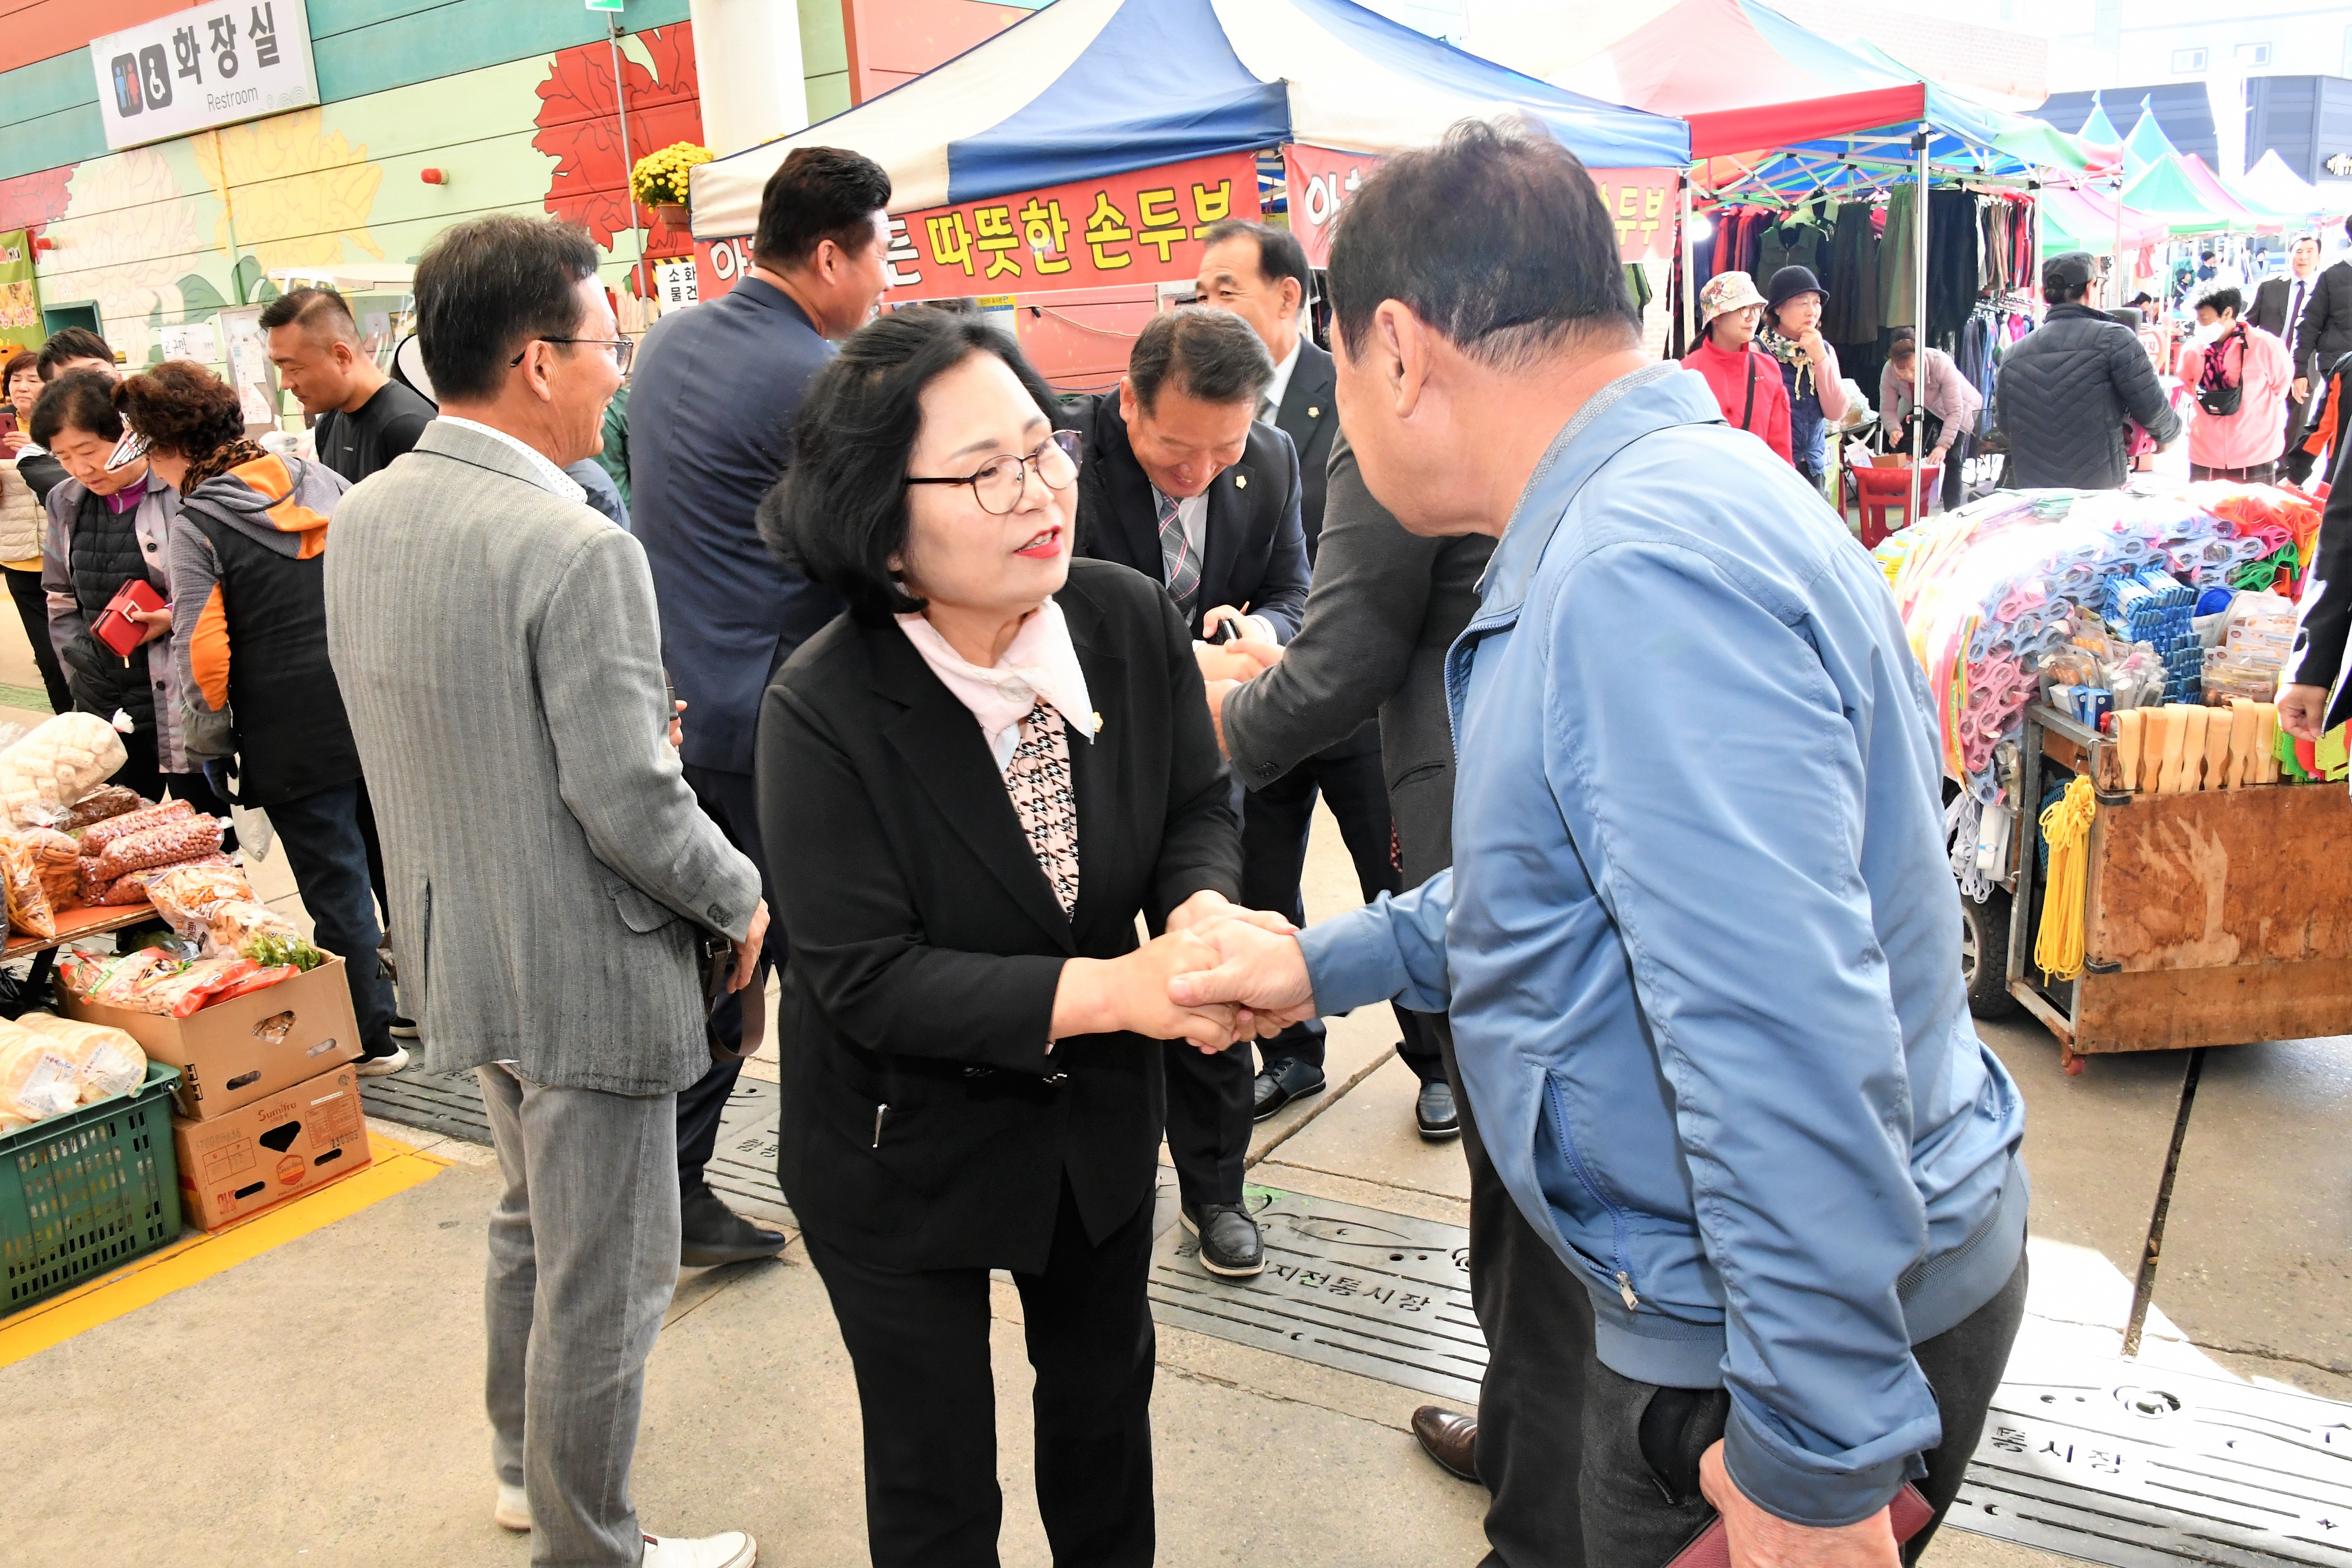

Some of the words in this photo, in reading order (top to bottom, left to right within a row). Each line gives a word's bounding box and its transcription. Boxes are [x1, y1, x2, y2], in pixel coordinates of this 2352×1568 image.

[172, 1, 280, 85] 화장실
[207, 87, 259, 112] Restroom
[710, 237, 754, 280] 아
[925, 197, 1071, 280] 따뜻한
[1085, 179, 1231, 270] 손두부
[88, 971, 111, 994] BARLEY
[258, 1102, 297, 1122] Sumifru
